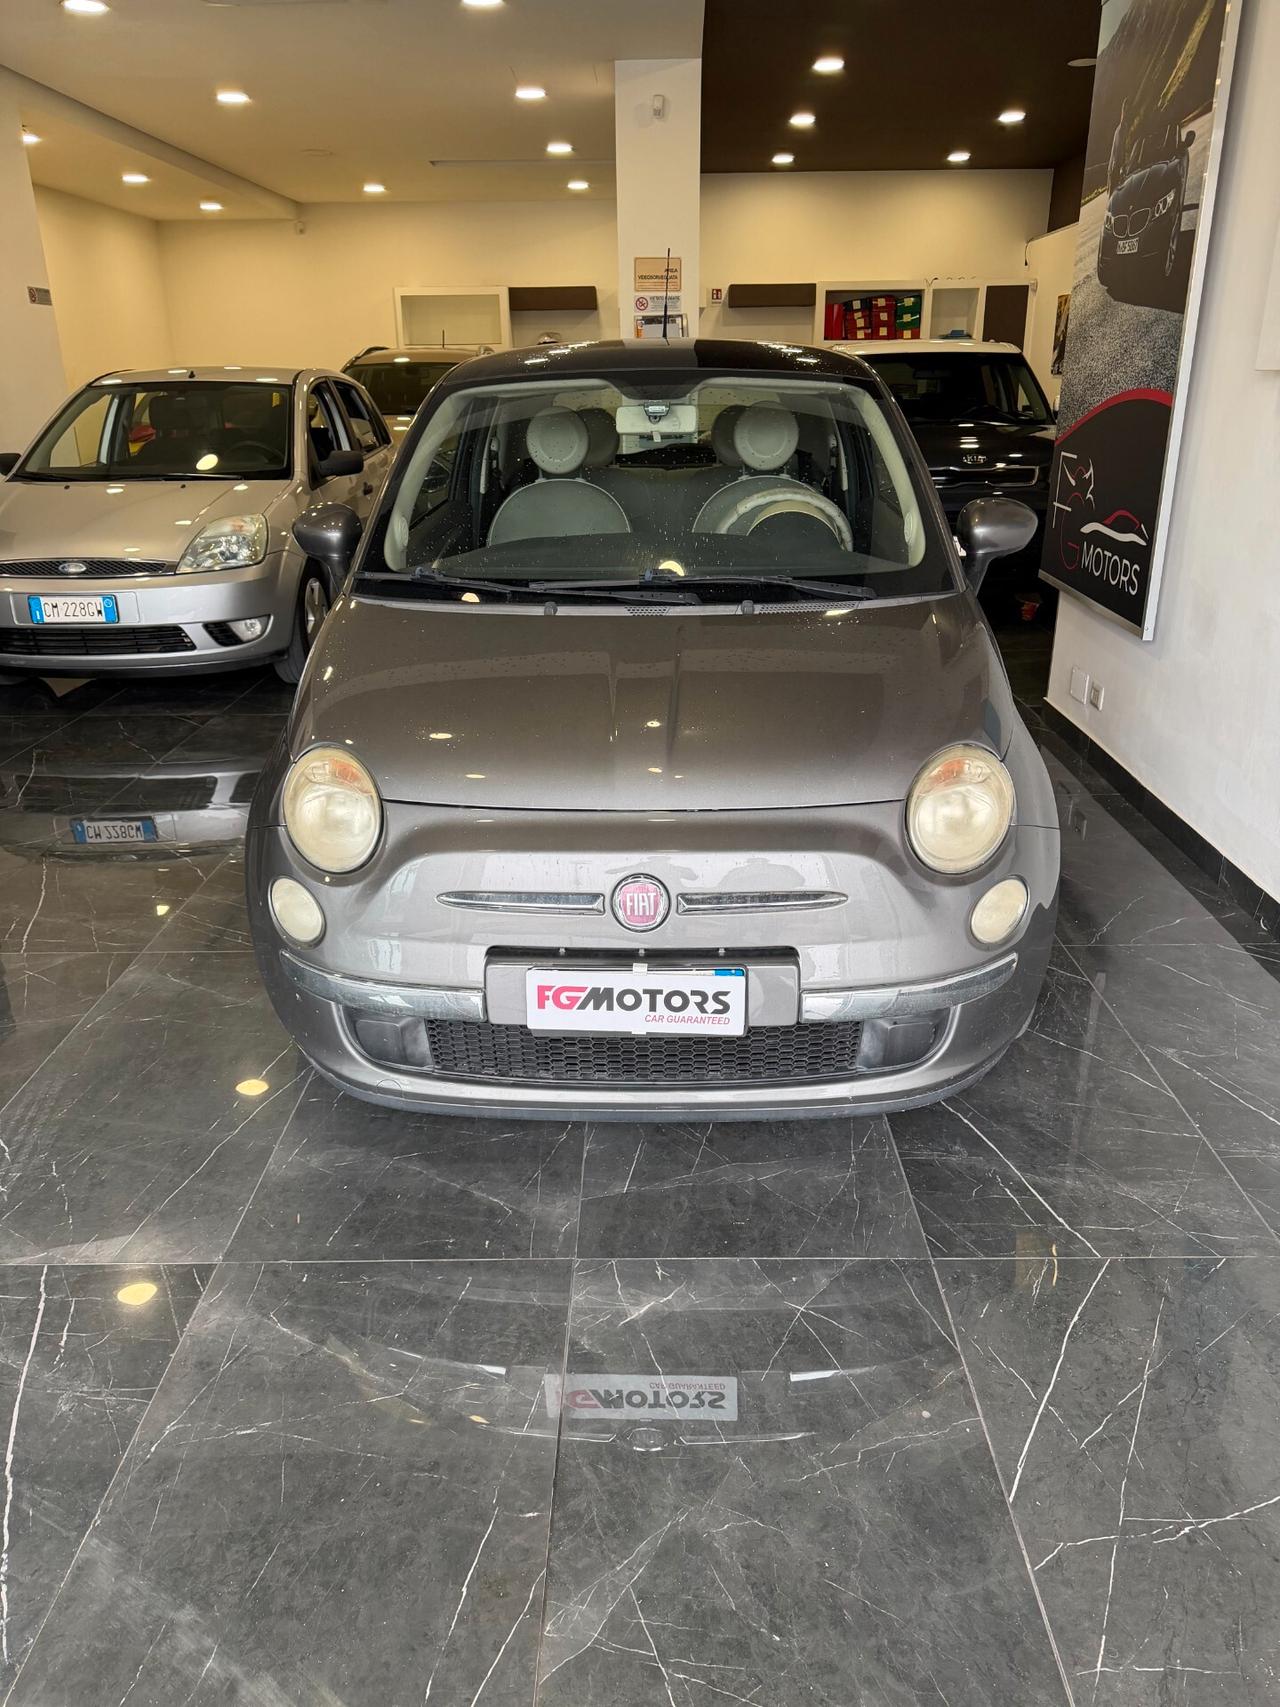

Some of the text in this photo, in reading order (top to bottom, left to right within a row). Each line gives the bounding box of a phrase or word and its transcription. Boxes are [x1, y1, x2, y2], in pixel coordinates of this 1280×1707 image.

[1081, 541, 1140, 595] MOTORS
[43, 602, 60, 617] CM
[62, 602, 103, 617] 228GW
[626, 892, 657, 917] FIAT
[644, 1014, 731, 1025] CAR GUARANTEED
